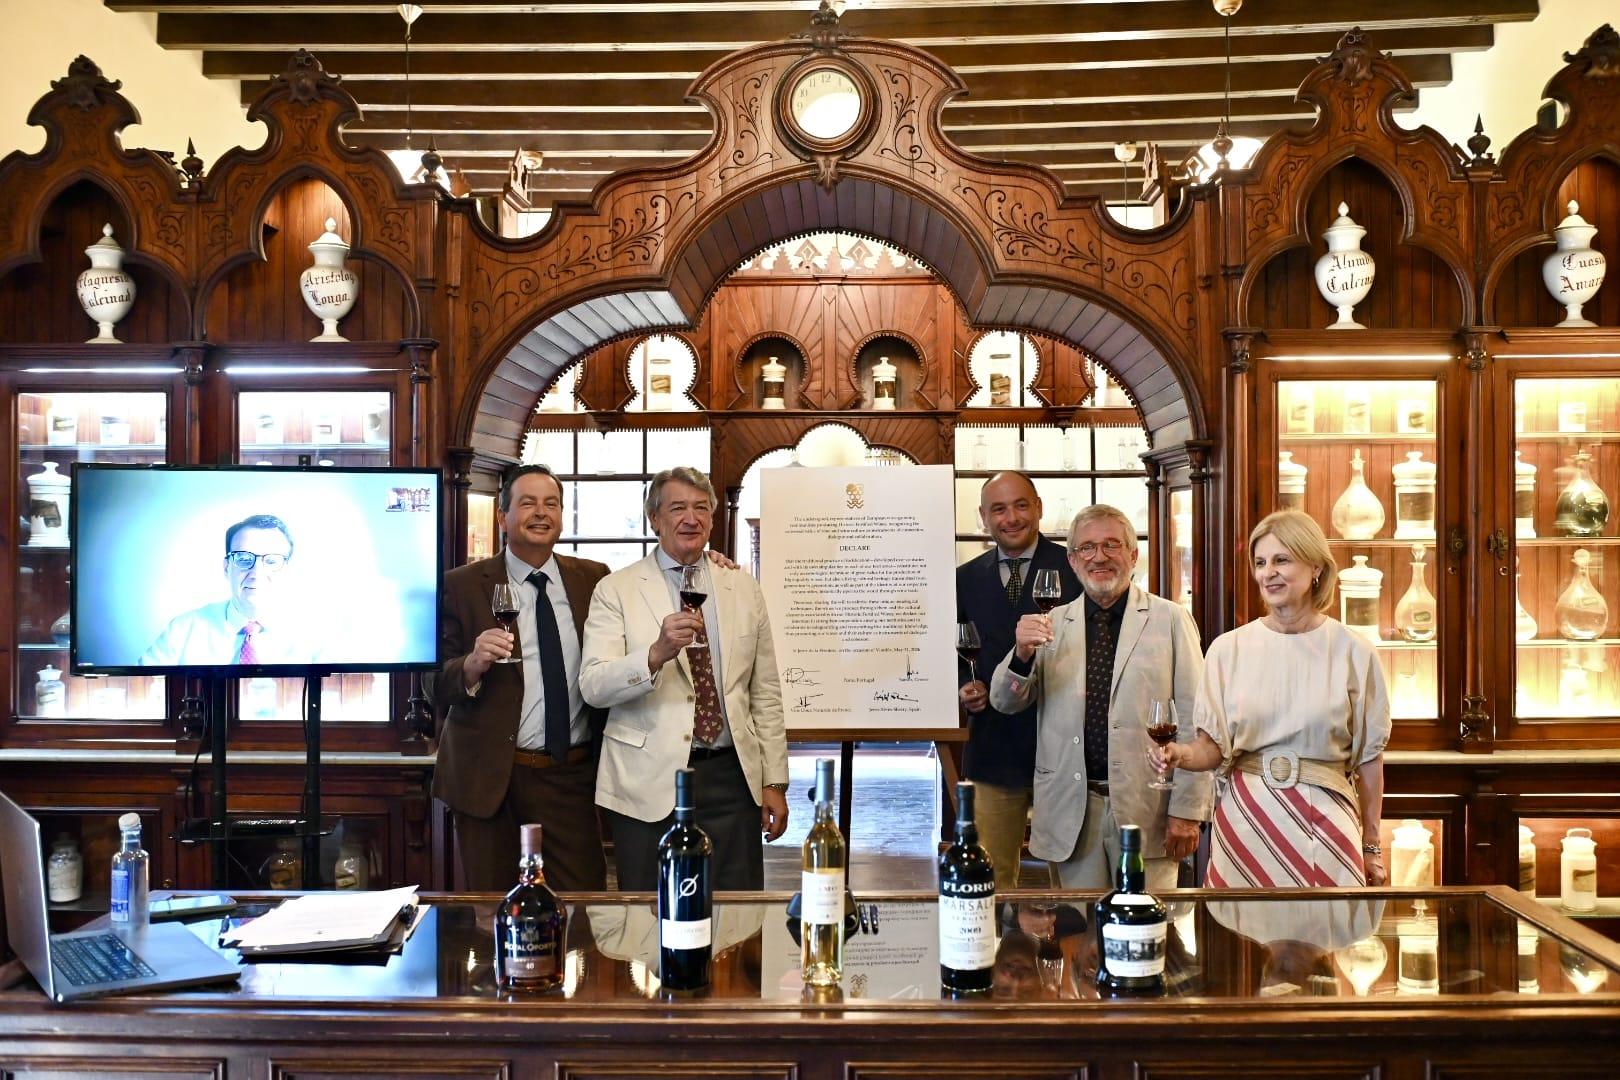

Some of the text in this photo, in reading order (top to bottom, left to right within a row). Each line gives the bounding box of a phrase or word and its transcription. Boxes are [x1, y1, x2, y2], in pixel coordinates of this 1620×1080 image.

[809, 79, 816, 88] 11
[820, 73, 832, 84] 12
[799, 88, 809, 98] 10
[943, 881, 995, 893] FLORIO
